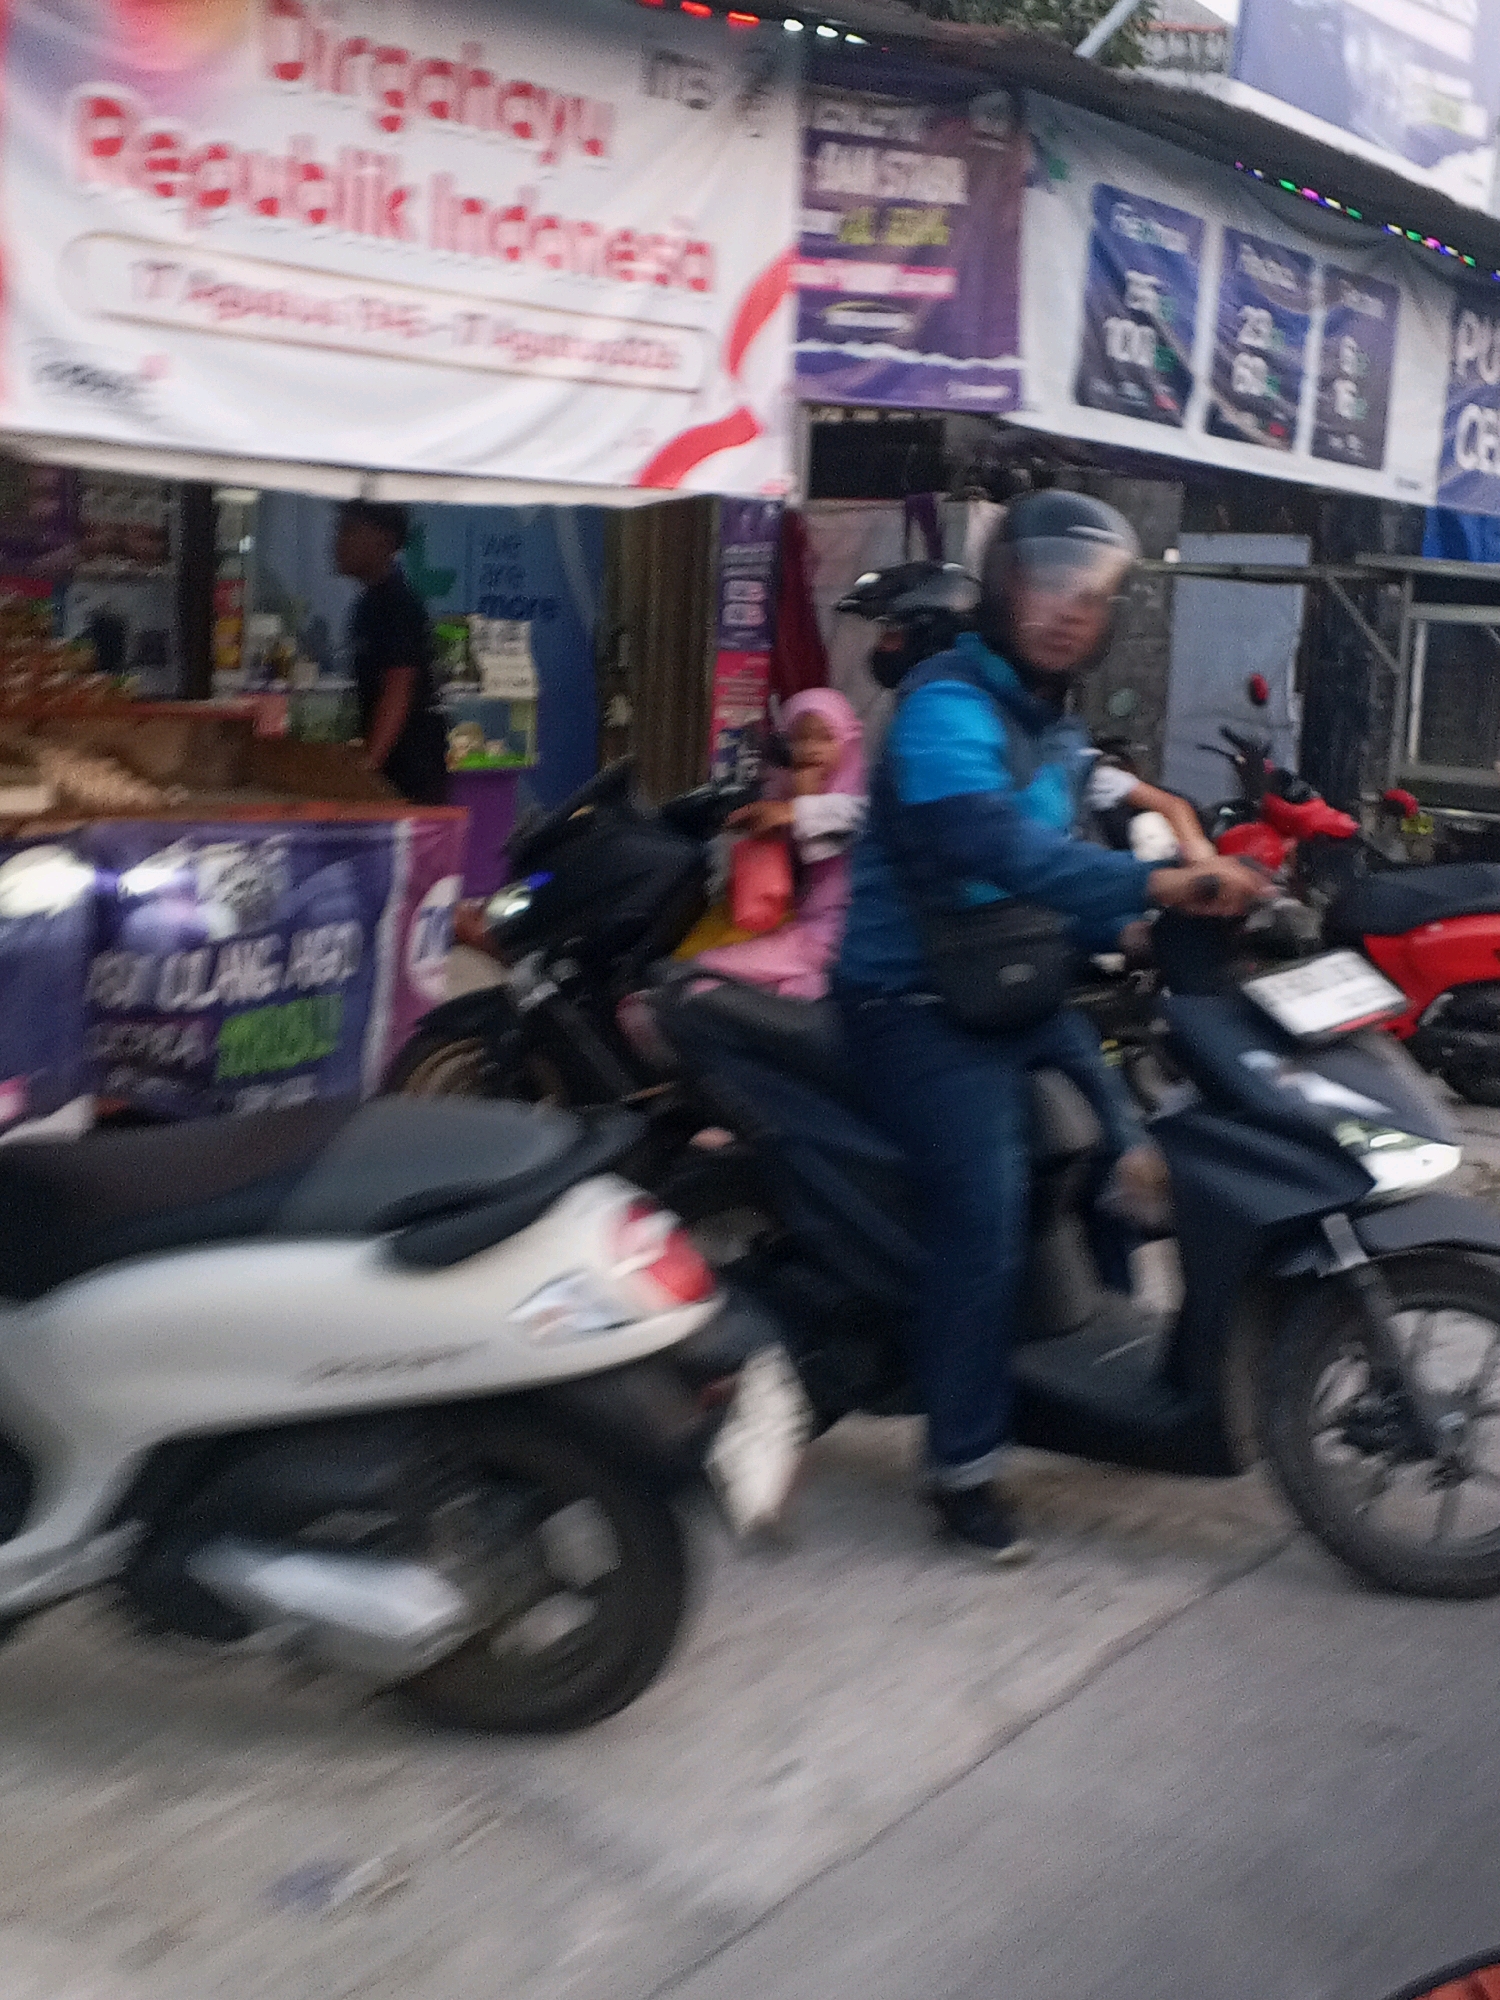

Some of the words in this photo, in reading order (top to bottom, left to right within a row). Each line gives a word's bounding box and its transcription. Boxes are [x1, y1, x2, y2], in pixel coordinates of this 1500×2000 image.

[262, 0, 617, 165] Dirgahayu
[76, 95, 418, 242] Republik
[427, 172, 716, 292] Indonesia
[476, 594, 560, 622] more
